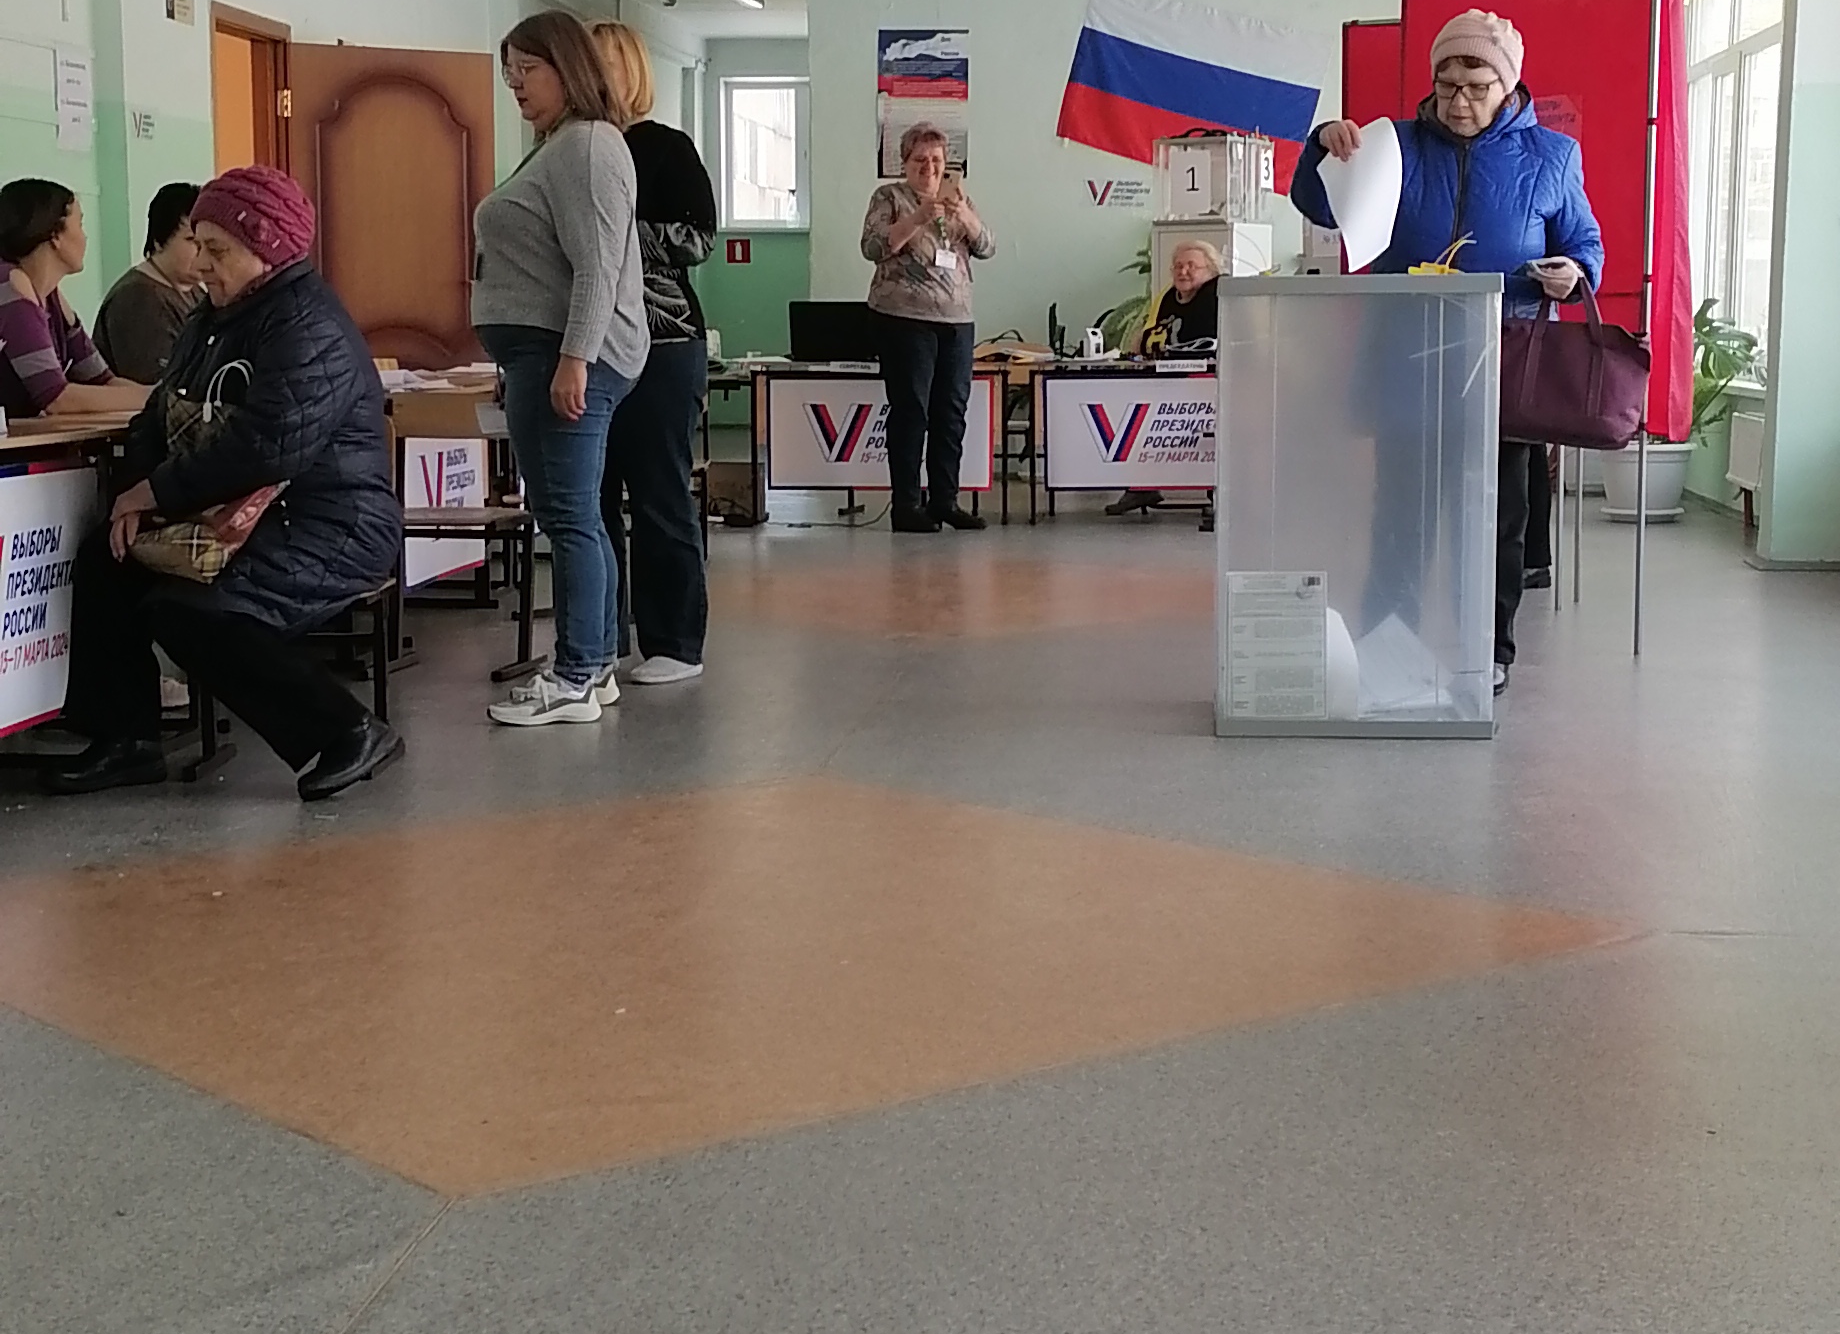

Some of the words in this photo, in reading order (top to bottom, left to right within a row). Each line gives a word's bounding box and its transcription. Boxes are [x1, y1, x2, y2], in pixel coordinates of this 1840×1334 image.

[1185, 166, 1201, 193] 1
[1263, 156, 1271, 182] 3
[1157, 402, 1217, 415] ВЫБОРЫ
[1150, 418, 1216, 434] ПРЕЗИДЕ
[1143, 435, 1200, 449] РОССИИ
[1165, 451, 1200, 463] МАРТА
[11, 524, 63, 560] ВЫБОРЫ
[2, 602, 48, 641] РОССИИ
[22, 636, 49, 668] МАРТА
